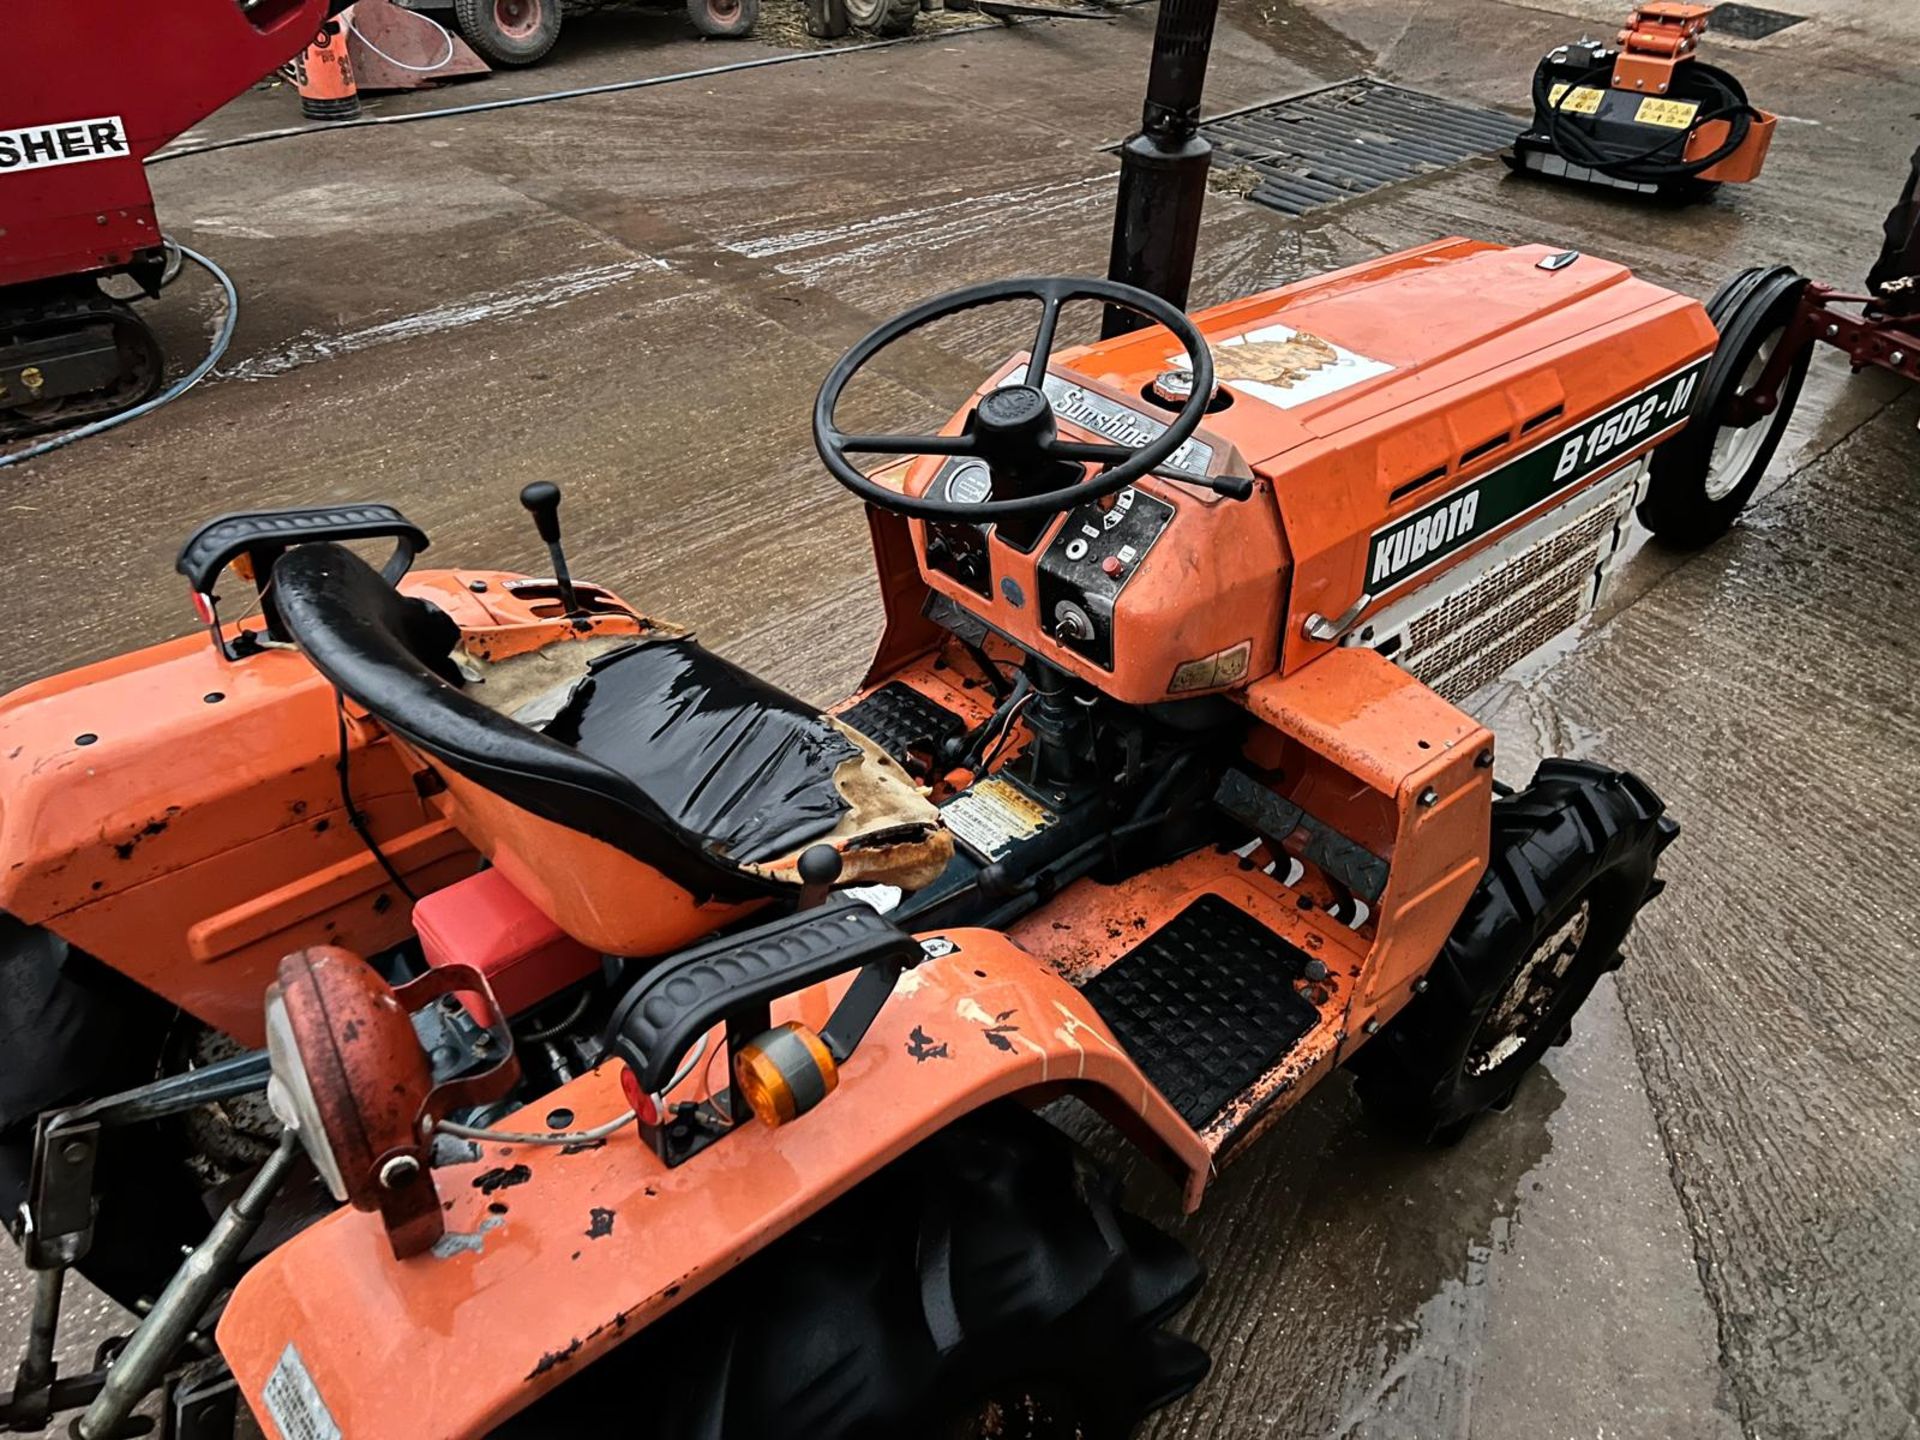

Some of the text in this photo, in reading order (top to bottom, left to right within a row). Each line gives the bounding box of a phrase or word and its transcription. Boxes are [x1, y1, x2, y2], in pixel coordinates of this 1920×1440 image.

[0, 120, 125, 167] SHER
[1053, 389, 1153, 448] Sunshine
[1371, 489, 1480, 584] KUBOTA
